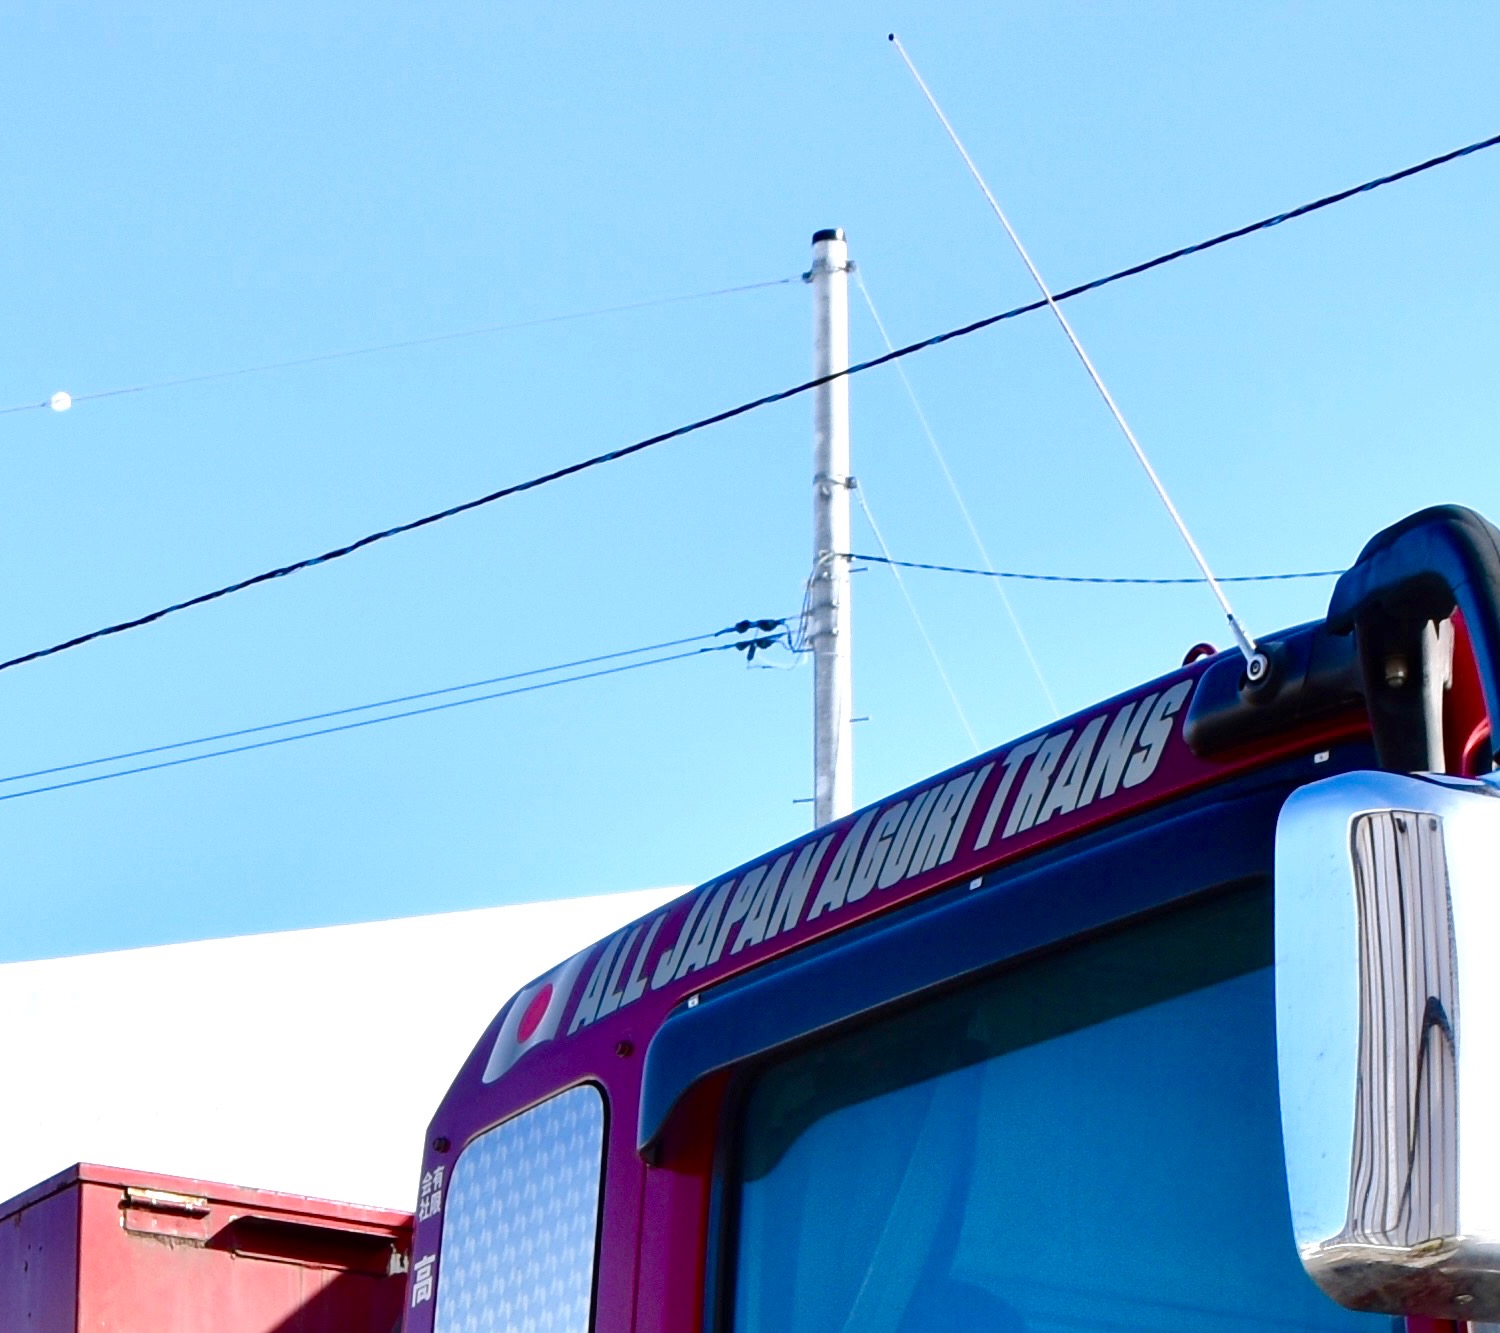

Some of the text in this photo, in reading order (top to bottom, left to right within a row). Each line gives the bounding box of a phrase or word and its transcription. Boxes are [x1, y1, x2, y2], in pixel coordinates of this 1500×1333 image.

[566, 679, 1194, 1037] ALL JAPAN AGURI TRANS
